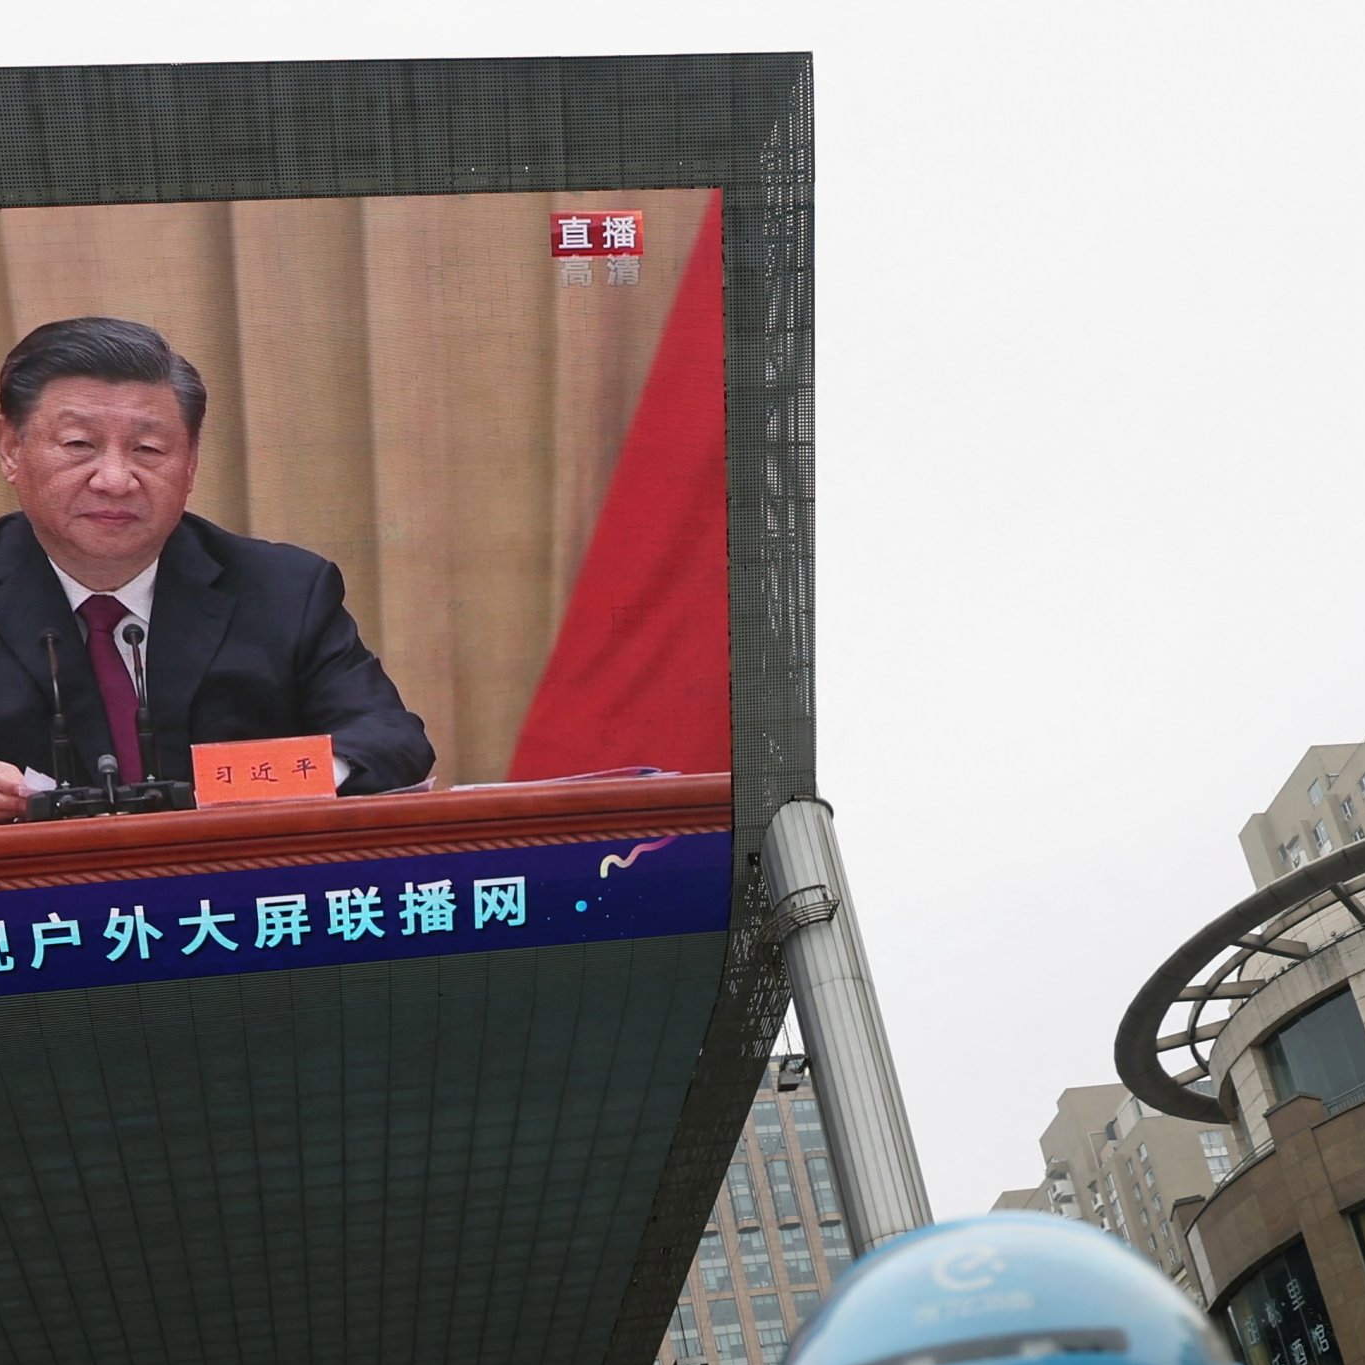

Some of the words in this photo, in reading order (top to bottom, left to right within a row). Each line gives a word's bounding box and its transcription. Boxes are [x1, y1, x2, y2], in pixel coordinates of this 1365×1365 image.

[557, 215, 637, 250] 直播
[559, 251, 641, 288] 高清
[215, 757, 317, 785] 习近平
